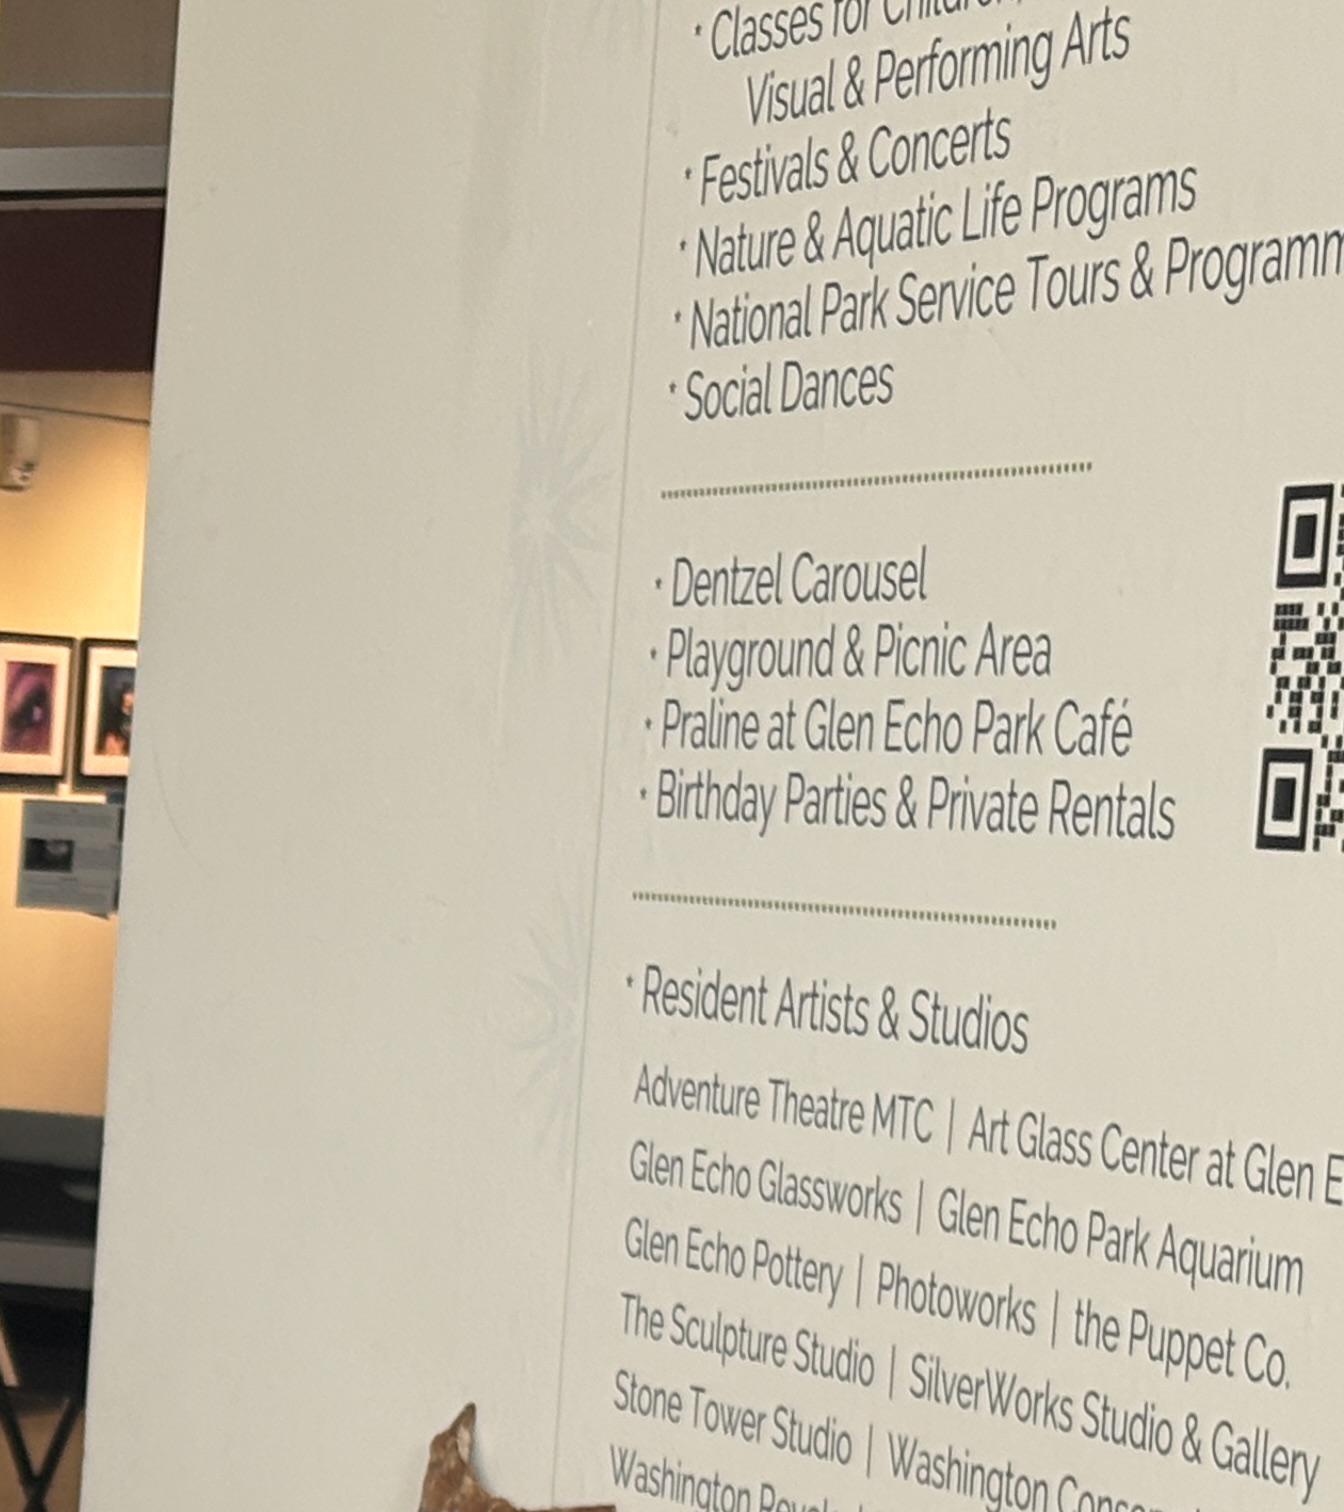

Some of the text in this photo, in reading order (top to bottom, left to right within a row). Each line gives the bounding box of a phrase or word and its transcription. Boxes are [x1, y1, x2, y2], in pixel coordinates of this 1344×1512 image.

[712, 2, 824, 60] Classes
[747, 5, 1130, 126] Visual & Performing Arts
[701, 107, 1011, 206] Festivals & Concerts
[696, 167, 1197, 278] Nature & Aquatic Life Programs
[691, 284, 811, 350] National
[821, 275, 889, 335] Park
[896, 262, 1015, 326] Service
[1027, 254, 1120, 311] Tours
[1130, 241, 1153, 300] &
[685, 361, 894, 421] Social Dances
[672, 544, 927, 607] Dentzel Carousel
[667, 621, 1051, 692] Playground & Picnic Area
[662, 697, 1132, 757] Praline at Glen Echo Park Café
[657, 768, 1176, 841] Birthday Parties & Private Rentals
[643, 964, 1029, 1054] Resident Artists & Studios
[634, 1063, 1344, 1206] Adventure Theatre MTC Art Glass Center at Glen E
[630, 1140, 1303, 1296] Glen Echo Glassworks Glen Echo Park Aquarium
[625, 1216, 1290, 1389] Glen Echo Pottery Photoworks the Puppet Co.
[614, 1369, 683, 1423] Stone
[690, 1385, 767, 1443] Tower
[772, 1405, 852, 1465] Studio
[621, 1292, 1320, 1505] The Sculpture Studio SilverWorks Studio & Gallery
